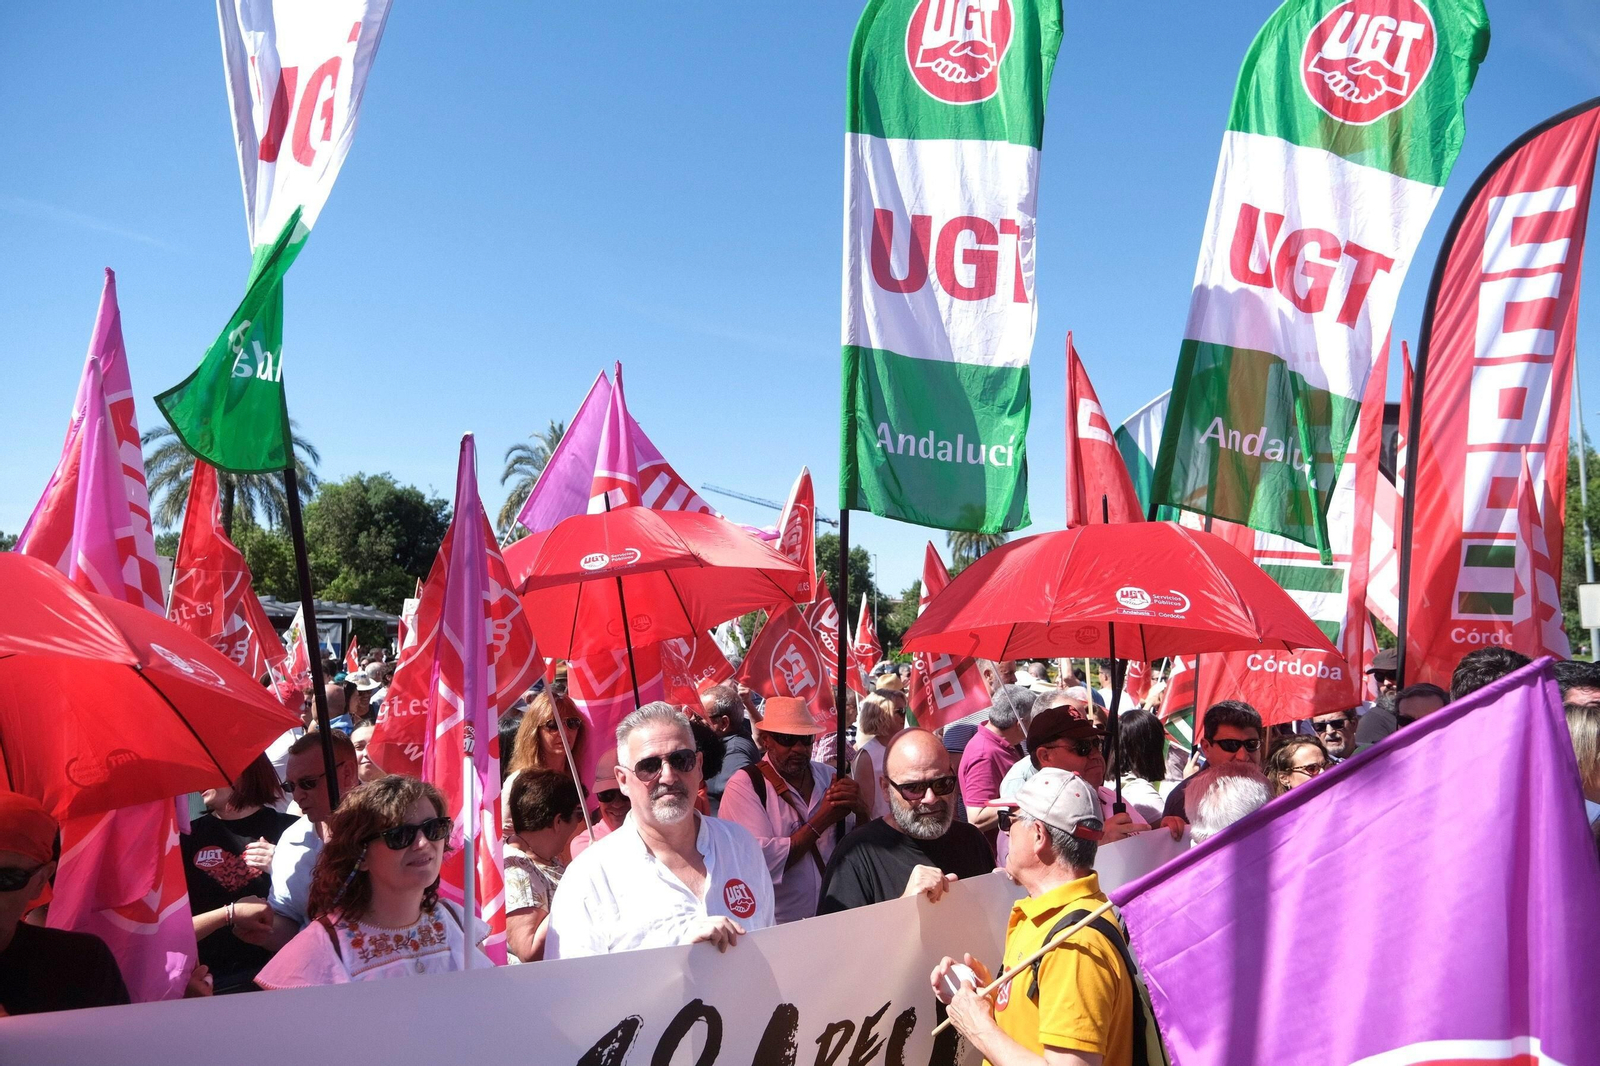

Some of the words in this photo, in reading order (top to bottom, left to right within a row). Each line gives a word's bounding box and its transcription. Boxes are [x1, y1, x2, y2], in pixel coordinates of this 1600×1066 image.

[921, 0, 999, 49] UGT
[1321, 10, 1425, 74] UGT
[1230, 203, 1395, 330] UGT
[876, 422, 1015, 467] Andalucí
[1199, 416, 1307, 473] Andalu
[584, 555, 605, 564] UGT
[1120, 590, 1145, 600] UGT
[169, 600, 212, 623] gt.es
[1246, 653, 1342, 681] Córdoba
[375, 697, 429, 724] gt.es
[198, 848, 223, 862] UGT
[725, 883, 749, 904] UGT
